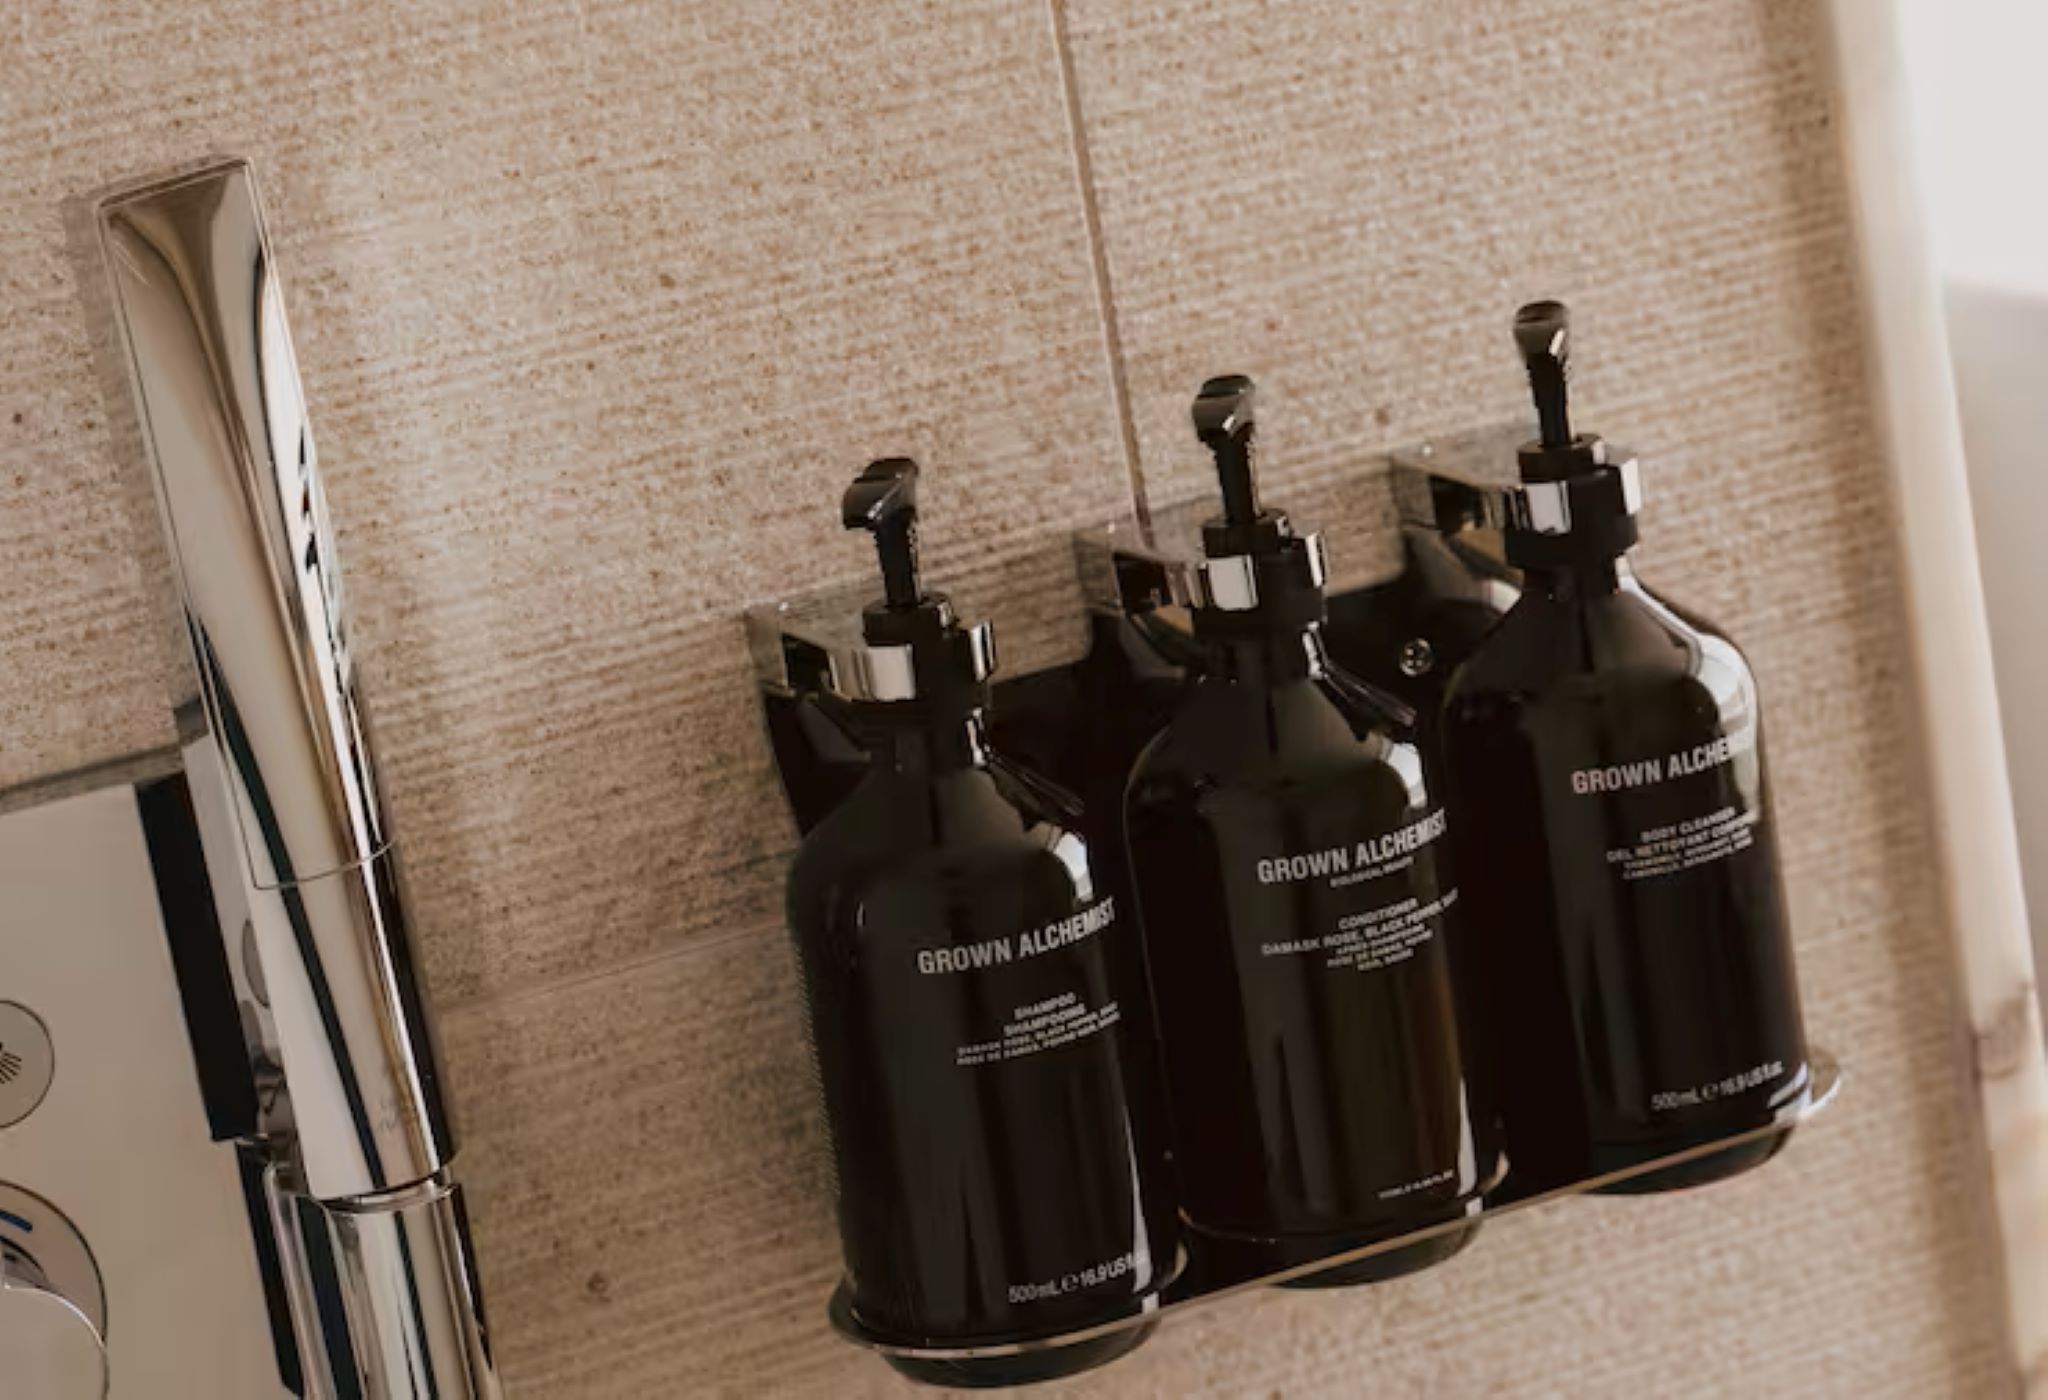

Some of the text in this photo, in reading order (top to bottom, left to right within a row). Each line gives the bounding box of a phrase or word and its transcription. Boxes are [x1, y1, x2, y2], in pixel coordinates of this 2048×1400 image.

[1571, 729, 1754, 795] GROWN ALCHE
[1257, 847, 1349, 884] GROWN
[1355, 807, 1448, 867] ALCHEMIST
[917, 895, 1116, 974] GROWN ALCHEMIST
